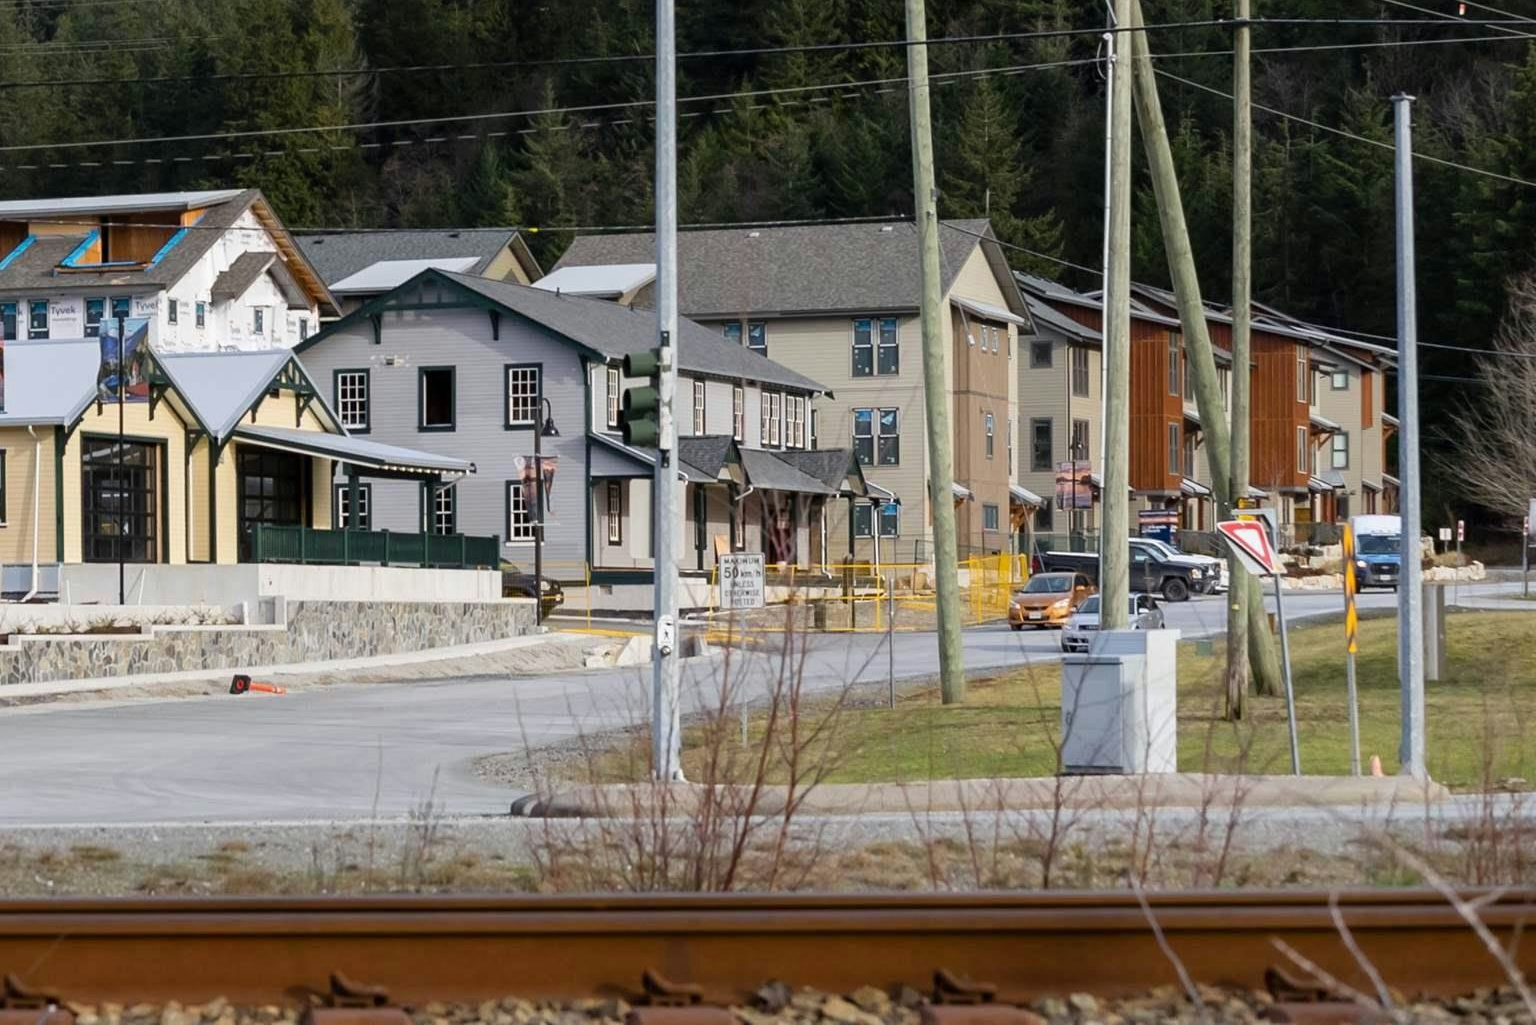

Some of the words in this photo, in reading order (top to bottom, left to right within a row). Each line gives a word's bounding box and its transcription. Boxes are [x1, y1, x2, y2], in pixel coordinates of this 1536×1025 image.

[52, 306, 76, 316] Tyvek
[724, 567, 739, 579] 50
[740, 568, 761, 577] km/h
[730, 580, 755, 588] UNLESS
